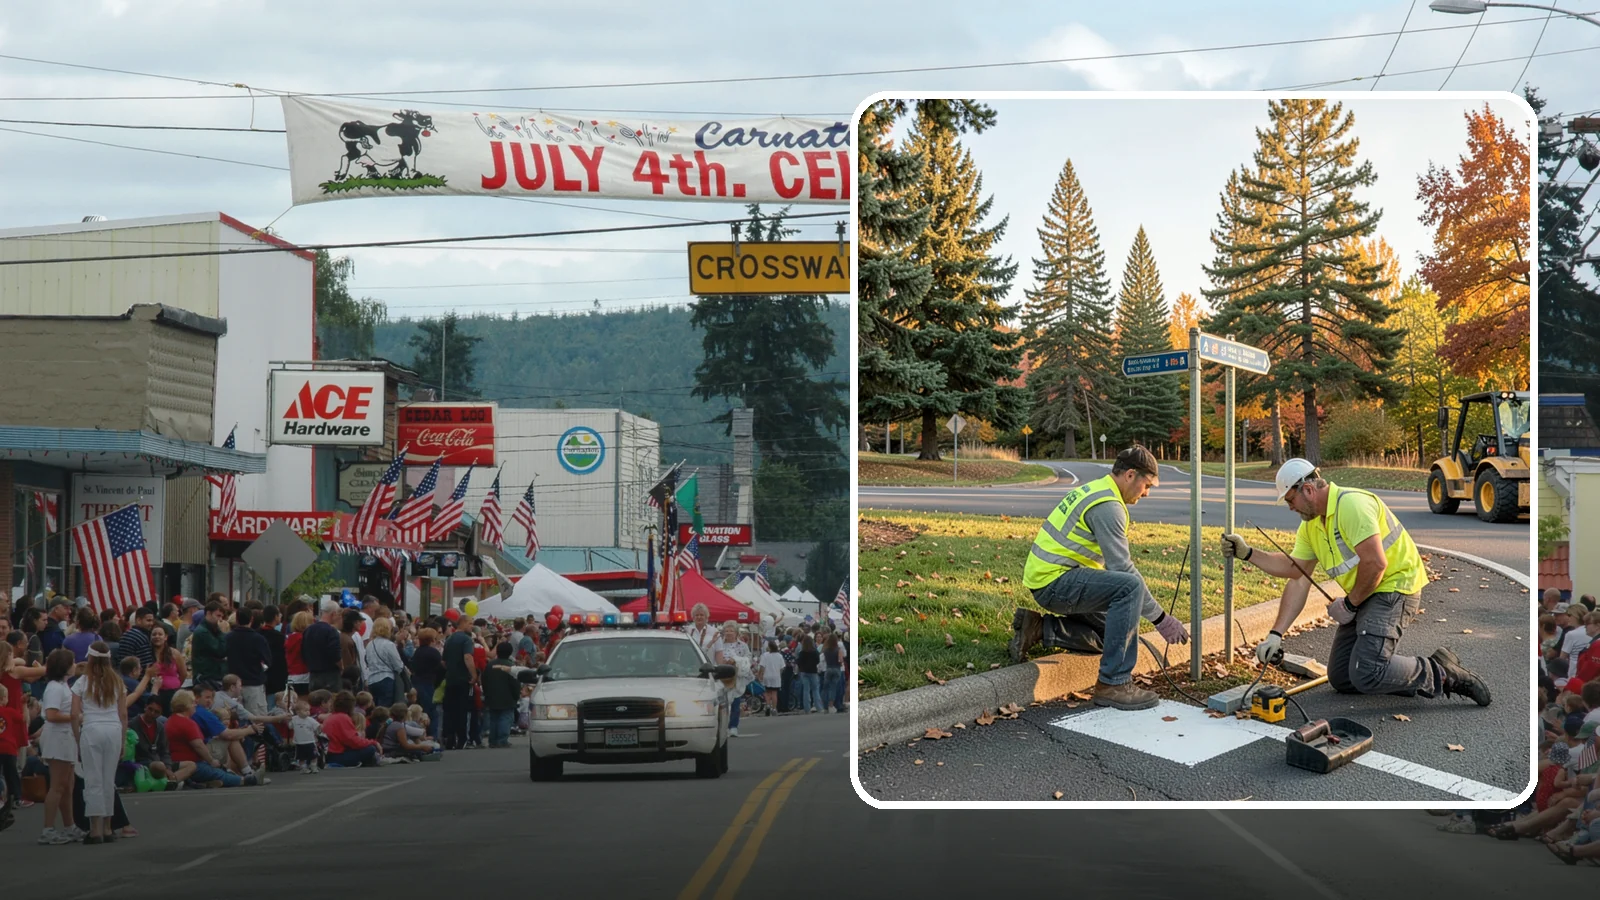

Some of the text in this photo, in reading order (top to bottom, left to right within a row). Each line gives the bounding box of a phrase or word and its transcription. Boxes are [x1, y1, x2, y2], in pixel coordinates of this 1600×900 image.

[481, 141, 604, 192] JULY
[632, 150, 747, 198] 4th.
[697, 254, 850, 280] CROSSWA
[283, 380, 373, 419] ACE
[405, 409, 453, 422] CEDAR
[283, 421, 371, 437] Hardware
[416, 428, 477, 447] Coca-Cola
[83, 485, 155, 495] St. Vincent de Paul
[212, 516, 331, 536] HARDARE
[688, 526, 741, 535] CRNATION
[699, 535, 730, 543] GLASS
